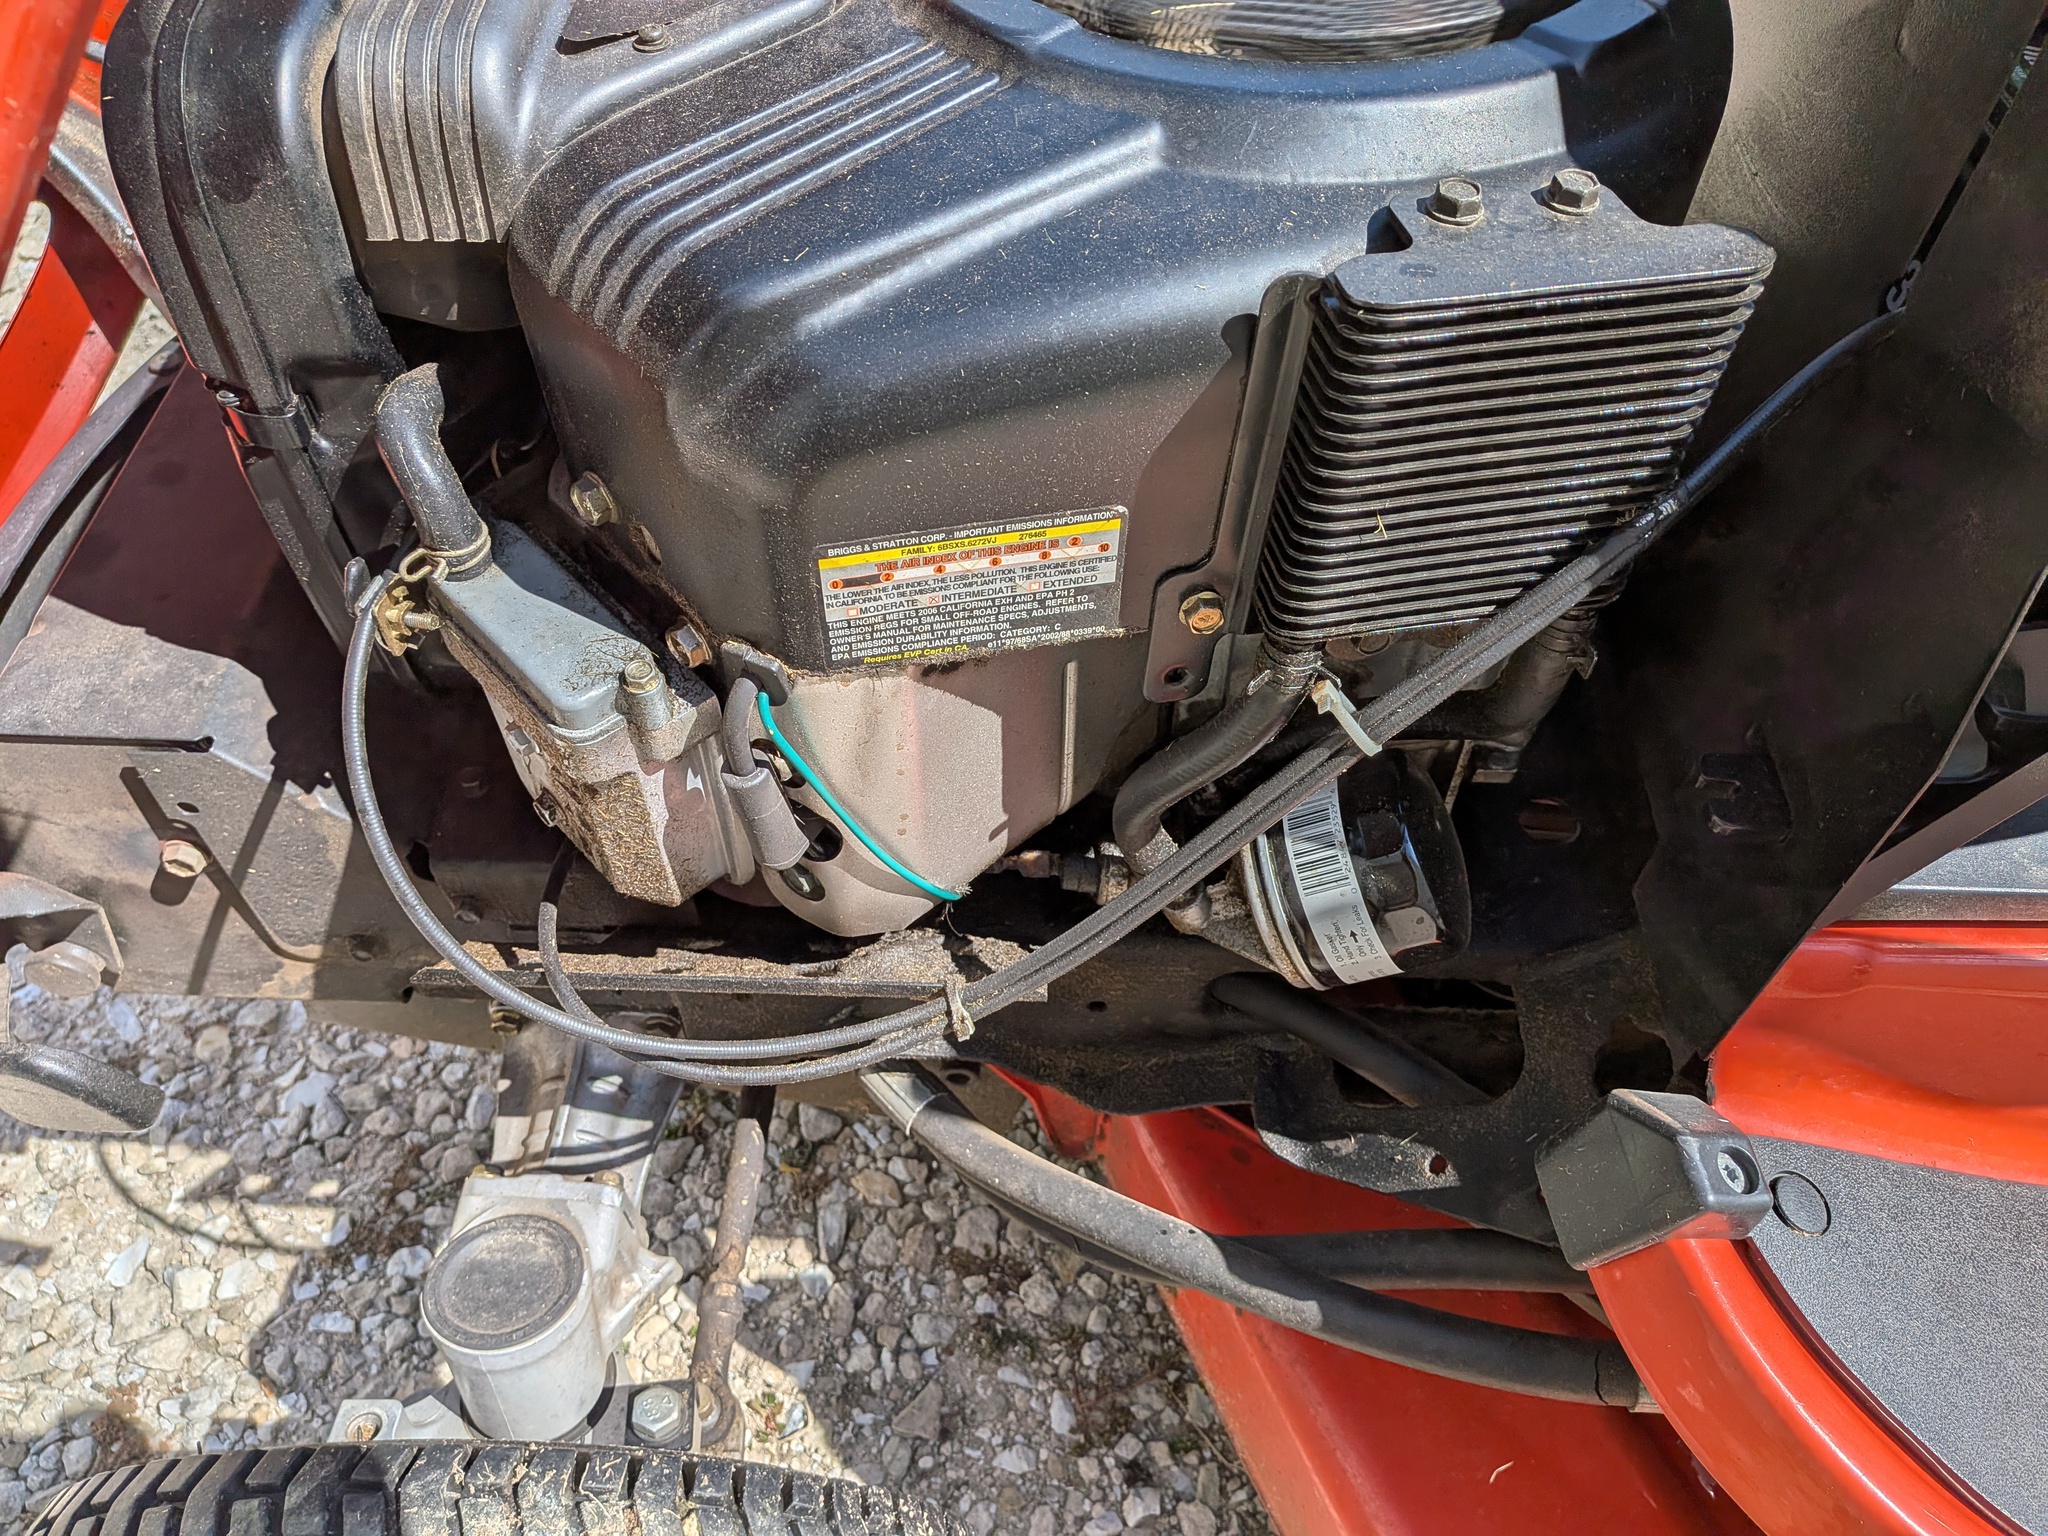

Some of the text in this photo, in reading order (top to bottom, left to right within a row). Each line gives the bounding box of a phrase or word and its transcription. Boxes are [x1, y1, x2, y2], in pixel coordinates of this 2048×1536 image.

[828, 545, 862, 557] BRIGGS
[872, 537, 919, 550] STRATTON
[920, 533, 948, 544] CORP.
[954, 525, 1004, 538] IMPORTANT
[1006, 518, 1052, 531] EMISSIONS
[1054, 511, 1114, 525] INFORMATION
[875, 561, 898, 572] THE
[901, 557, 920, 568] AIR
[923, 552, 957, 565] INDEX
[959, 550, 975, 560] OF
[977, 547, 1004, 558] THIS
[1006, 541, 1046, 554] ENGINE
[1049, 539, 1060, 548] IS
[901, 546, 936, 556] FAMILY:
[835, 596, 883, 608] CALIFORNIA
[909, 584, 951, 597] EMISSIONS
[952, 578, 999, 591] COMPLIANT
[1000, 576, 1016, 584] FOR
[1018, 573, 1032, 582] THE
[1034, 568, 1080, 579] FOLLOWING
[1082, 565, 1100, 574] USE:
[843, 590, 872, 598] LOWER
[874, 587, 890, 595] THE
[934, 578, 949, 586] THE
[950, 574, 969, 583] LESS
[970, 568, 1017, 580] POLLUTION.
[1020, 565, 1038, 574] THIS
[1039, 561, 1068, 572] ENGINE
[1078, 555, 1117, 566] CERTIFIED
[827, 622, 848, 630] THIS
[850, 616, 884, 627] ENGINE
[886, 612, 916, 622] MEETS
[918, 607, 938, 616] 2006
[940, 600, 994, 613] CALIFORNIA
[994, 597, 1012, 606] EXH
[1014, 594, 1034, 603] AND
[1036, 592, 1053, 600] EPA
[860, 574, 1098, 616] MODERATE INTERMEDIATE EXTENDED
[828, 626, 872, 638] EMISSION
[874, 621, 898, 631] REGS
[900, 618, 919, 626] FOR
[920, 613, 950, 624] SMALL
[953, 606, 998, 620] OFF-ROAD
[1000, 602, 1040, 612] ENGINES.
[1046, 596, 1074, 607] REFER
[830, 602, 1096, 646] OWNER'S MANUAL FOR MAINTENANCE SPECS, ADJUSTMENTS,
[830, 623, 1012, 654] AND EMISSION DURABILITY INFORMATION.
[832, 653, 850, 661] EPA
[852, 646, 900, 658] EMISSIONS
[902, 637, 958, 650] COMPLIANCE
[960, 632, 996, 643] PERIOD:
[1000, 625, 1050, 638] CATEGORY:
[864, 654, 902, 664] Requires
[904, 650, 921, 658] EVP
[924, 648, 943, 656] Cert
[1330, 804, 1341, 834] 23529
[1352, 904, 1364, 926] Leaks
[1360, 926, 1370, 938] For
[1364, 938, 1378, 955] Check
[1342, 945, 1355, 960] Hand
[1356, 944, 1367, 958] Only
